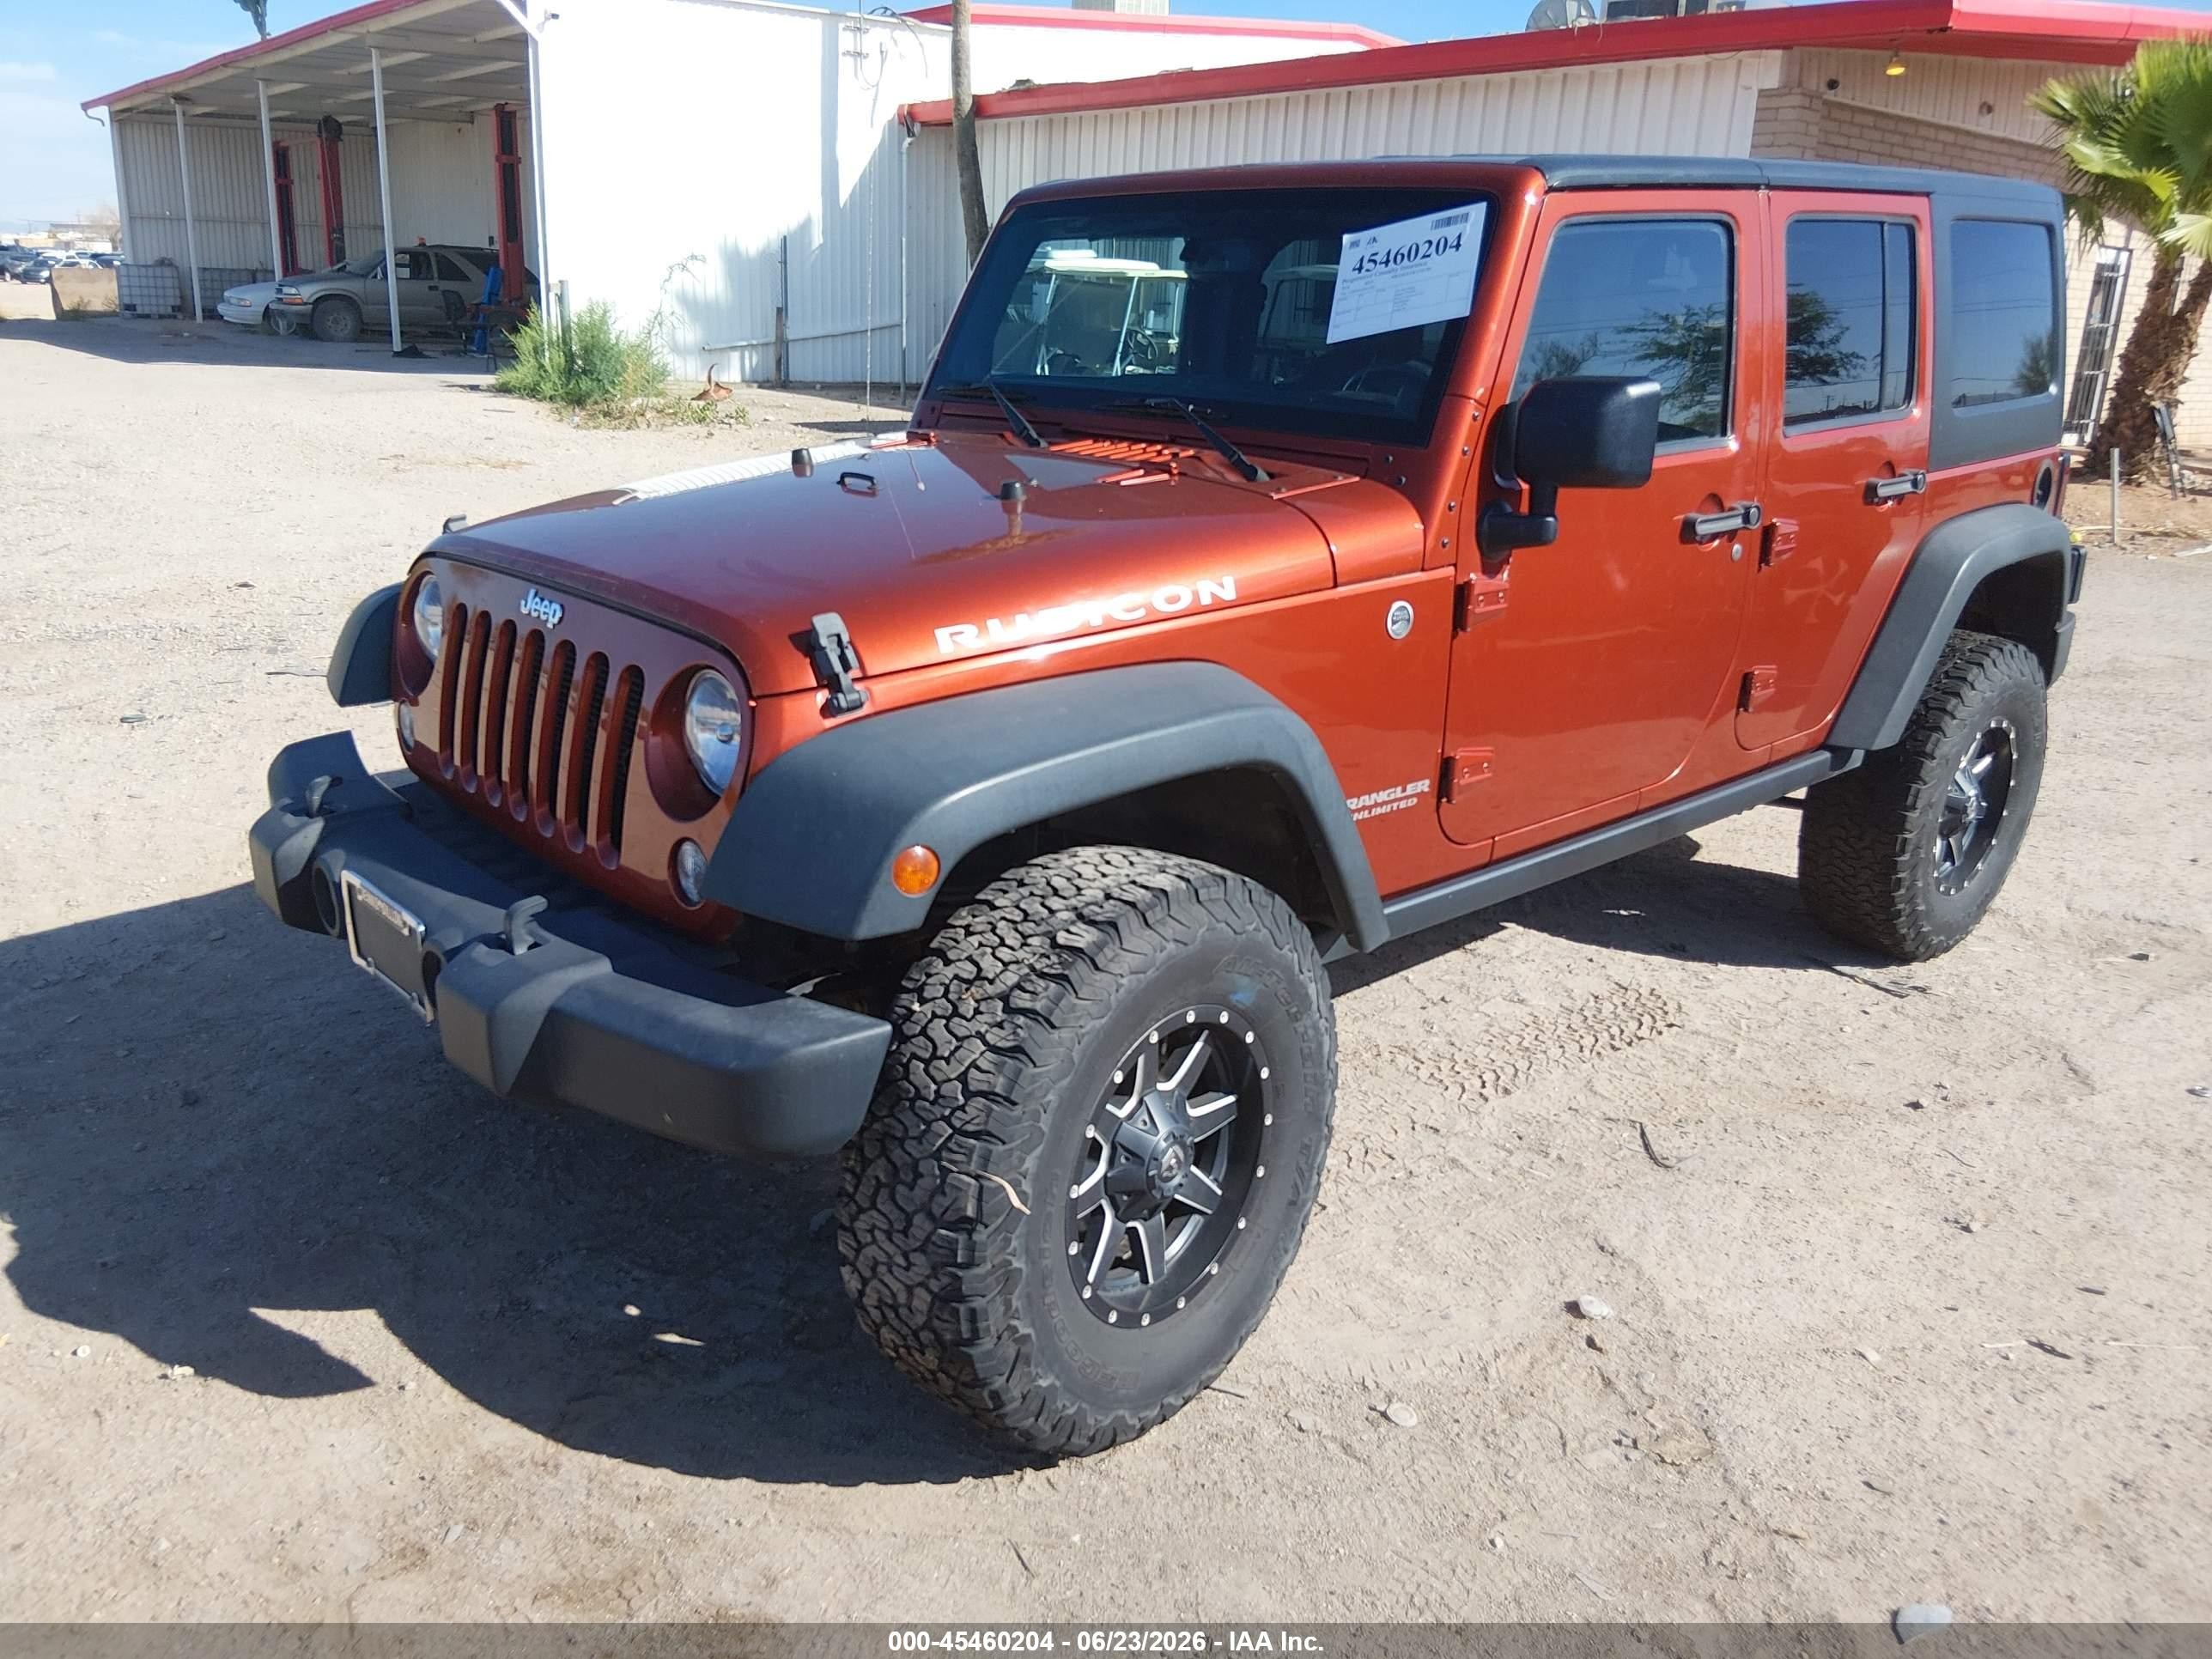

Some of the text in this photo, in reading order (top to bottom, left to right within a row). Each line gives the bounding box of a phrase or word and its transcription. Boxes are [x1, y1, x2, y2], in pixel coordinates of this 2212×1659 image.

[1352, 232, 1463, 274] 45460204
[520, 588, 563, 629] Jeep
[1346, 779, 1431, 811] RANGLER
[1351, 797, 1419, 822] NLIMITED
